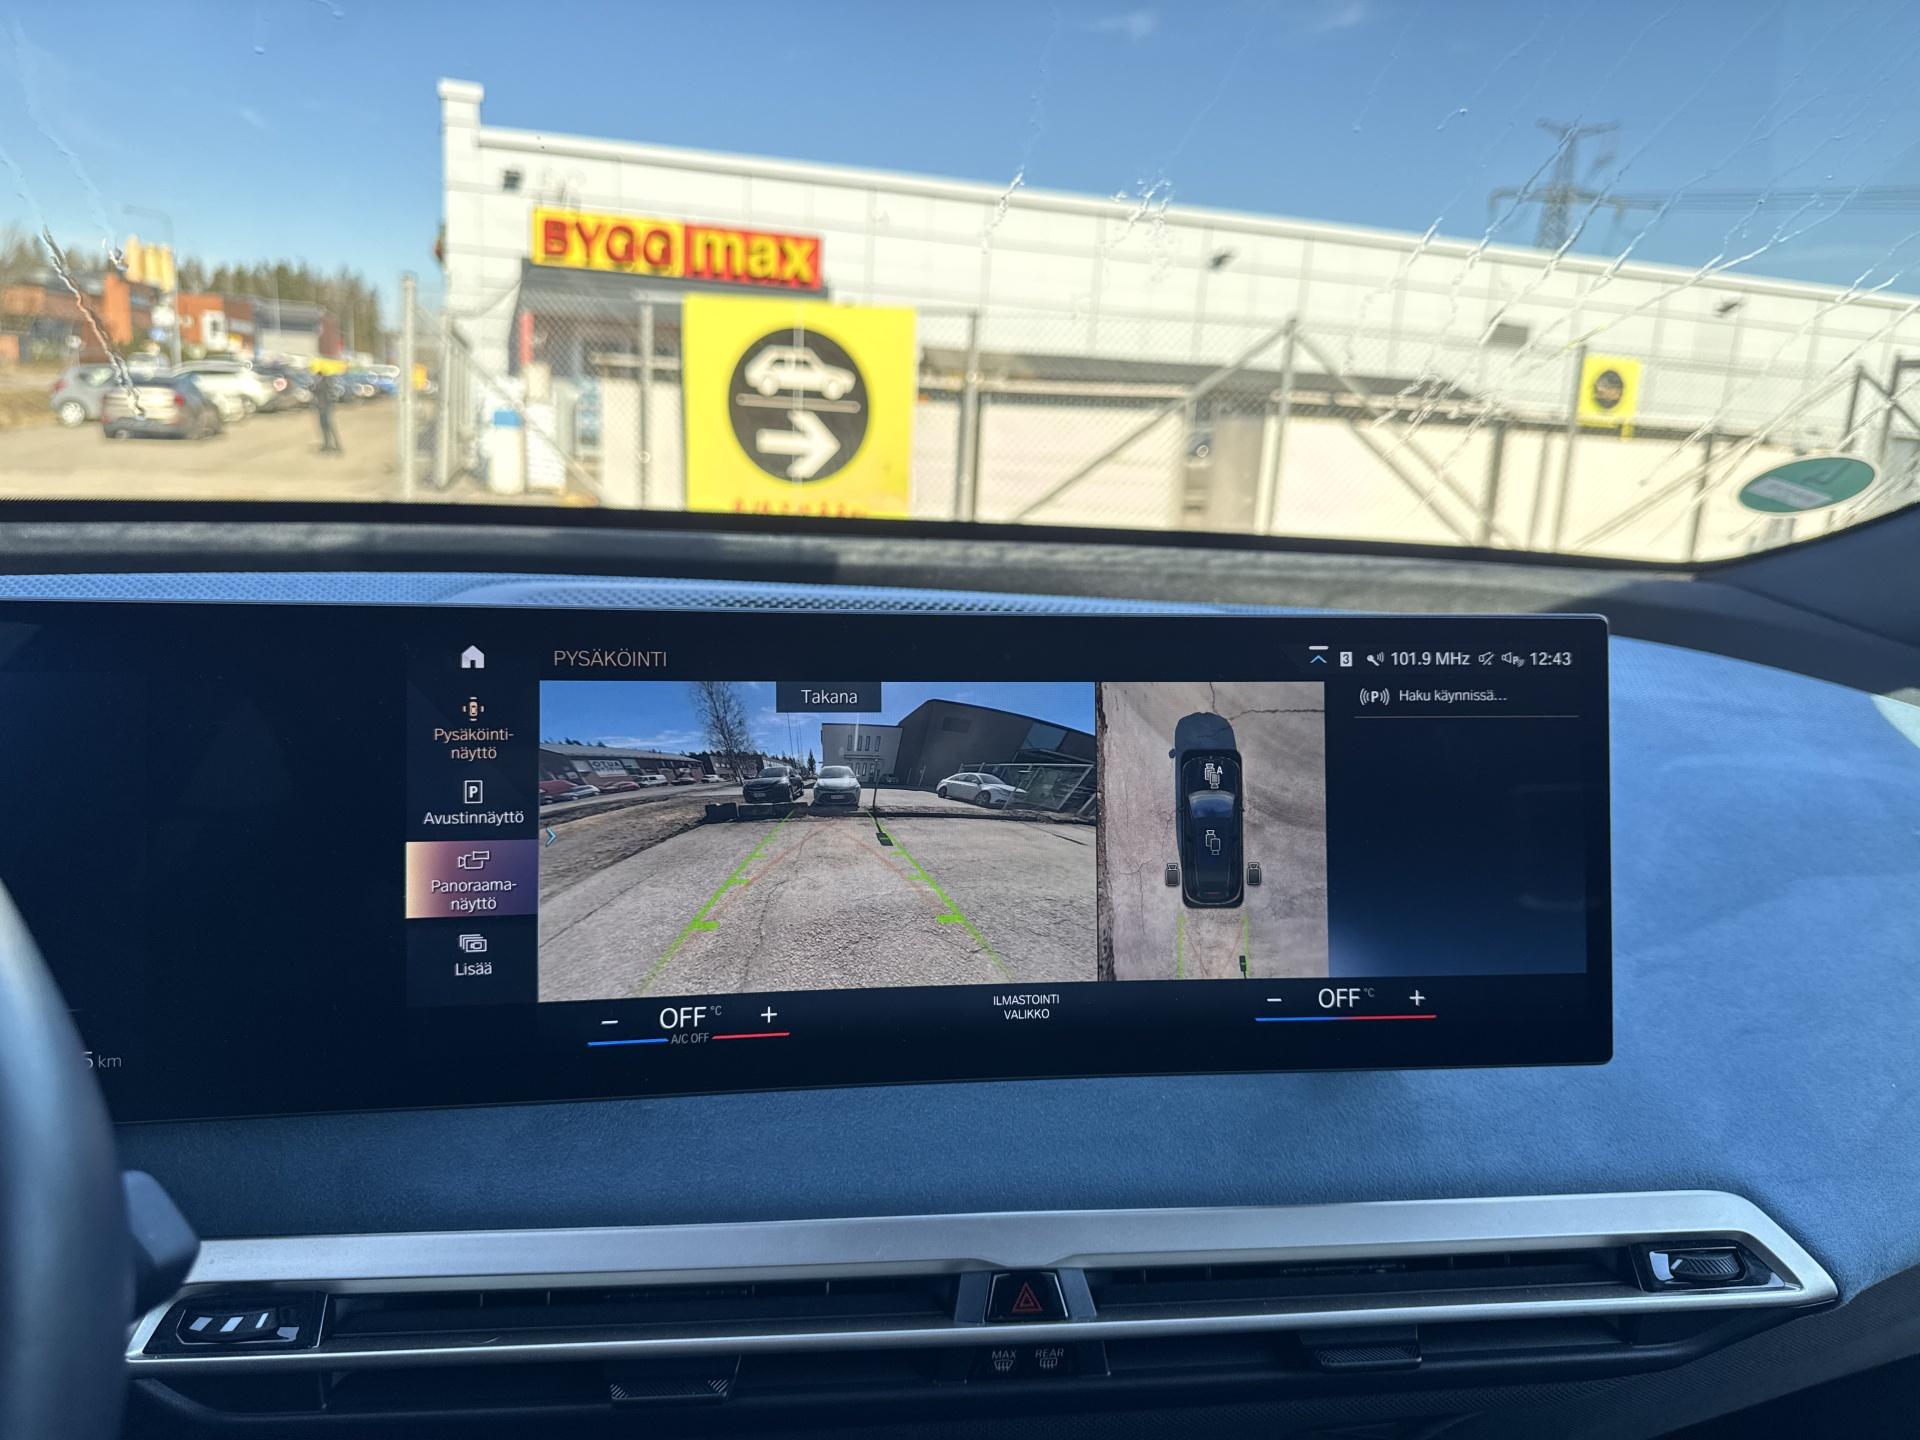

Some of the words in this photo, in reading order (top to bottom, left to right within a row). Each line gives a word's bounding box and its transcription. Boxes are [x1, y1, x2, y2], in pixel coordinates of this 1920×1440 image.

[553, 648, 668, 667] PYSÄKÖINTI
[1390, 651, 1432, 666] 101.9
[1435, 651, 1471, 666] MHz
[1529, 651, 1572, 666] 12:43
[800, 689, 857, 704] Takana
[1399, 689, 1431, 702] Haku
[1434, 689, 1508, 704] käynnissä...
[433, 727, 515, 745] Pysäköinti-
[450, 746, 498, 762] näyttö
[423, 810, 525, 826] Avustinnäyttö
[431, 878, 518, 894] Panoraama-
[450, 896, 498, 912] näyttö
[455, 961, 493, 977] Lisää
[992, 995, 1060, 1007] ILMASTOINTI
[1318, 988, 1361, 1009] OFF
[659, 1006, 707, 1029] OFF
[1003, 1009, 1051, 1021] VALIKKO
[671, 1034, 689, 1045] A/C
[690, 1032, 709, 1044] OFF
[98, 1055, 122, 1068] km
[991, 1350, 1016, 1359] MAX
[1035, 1348, 1064, 1358] REAR
